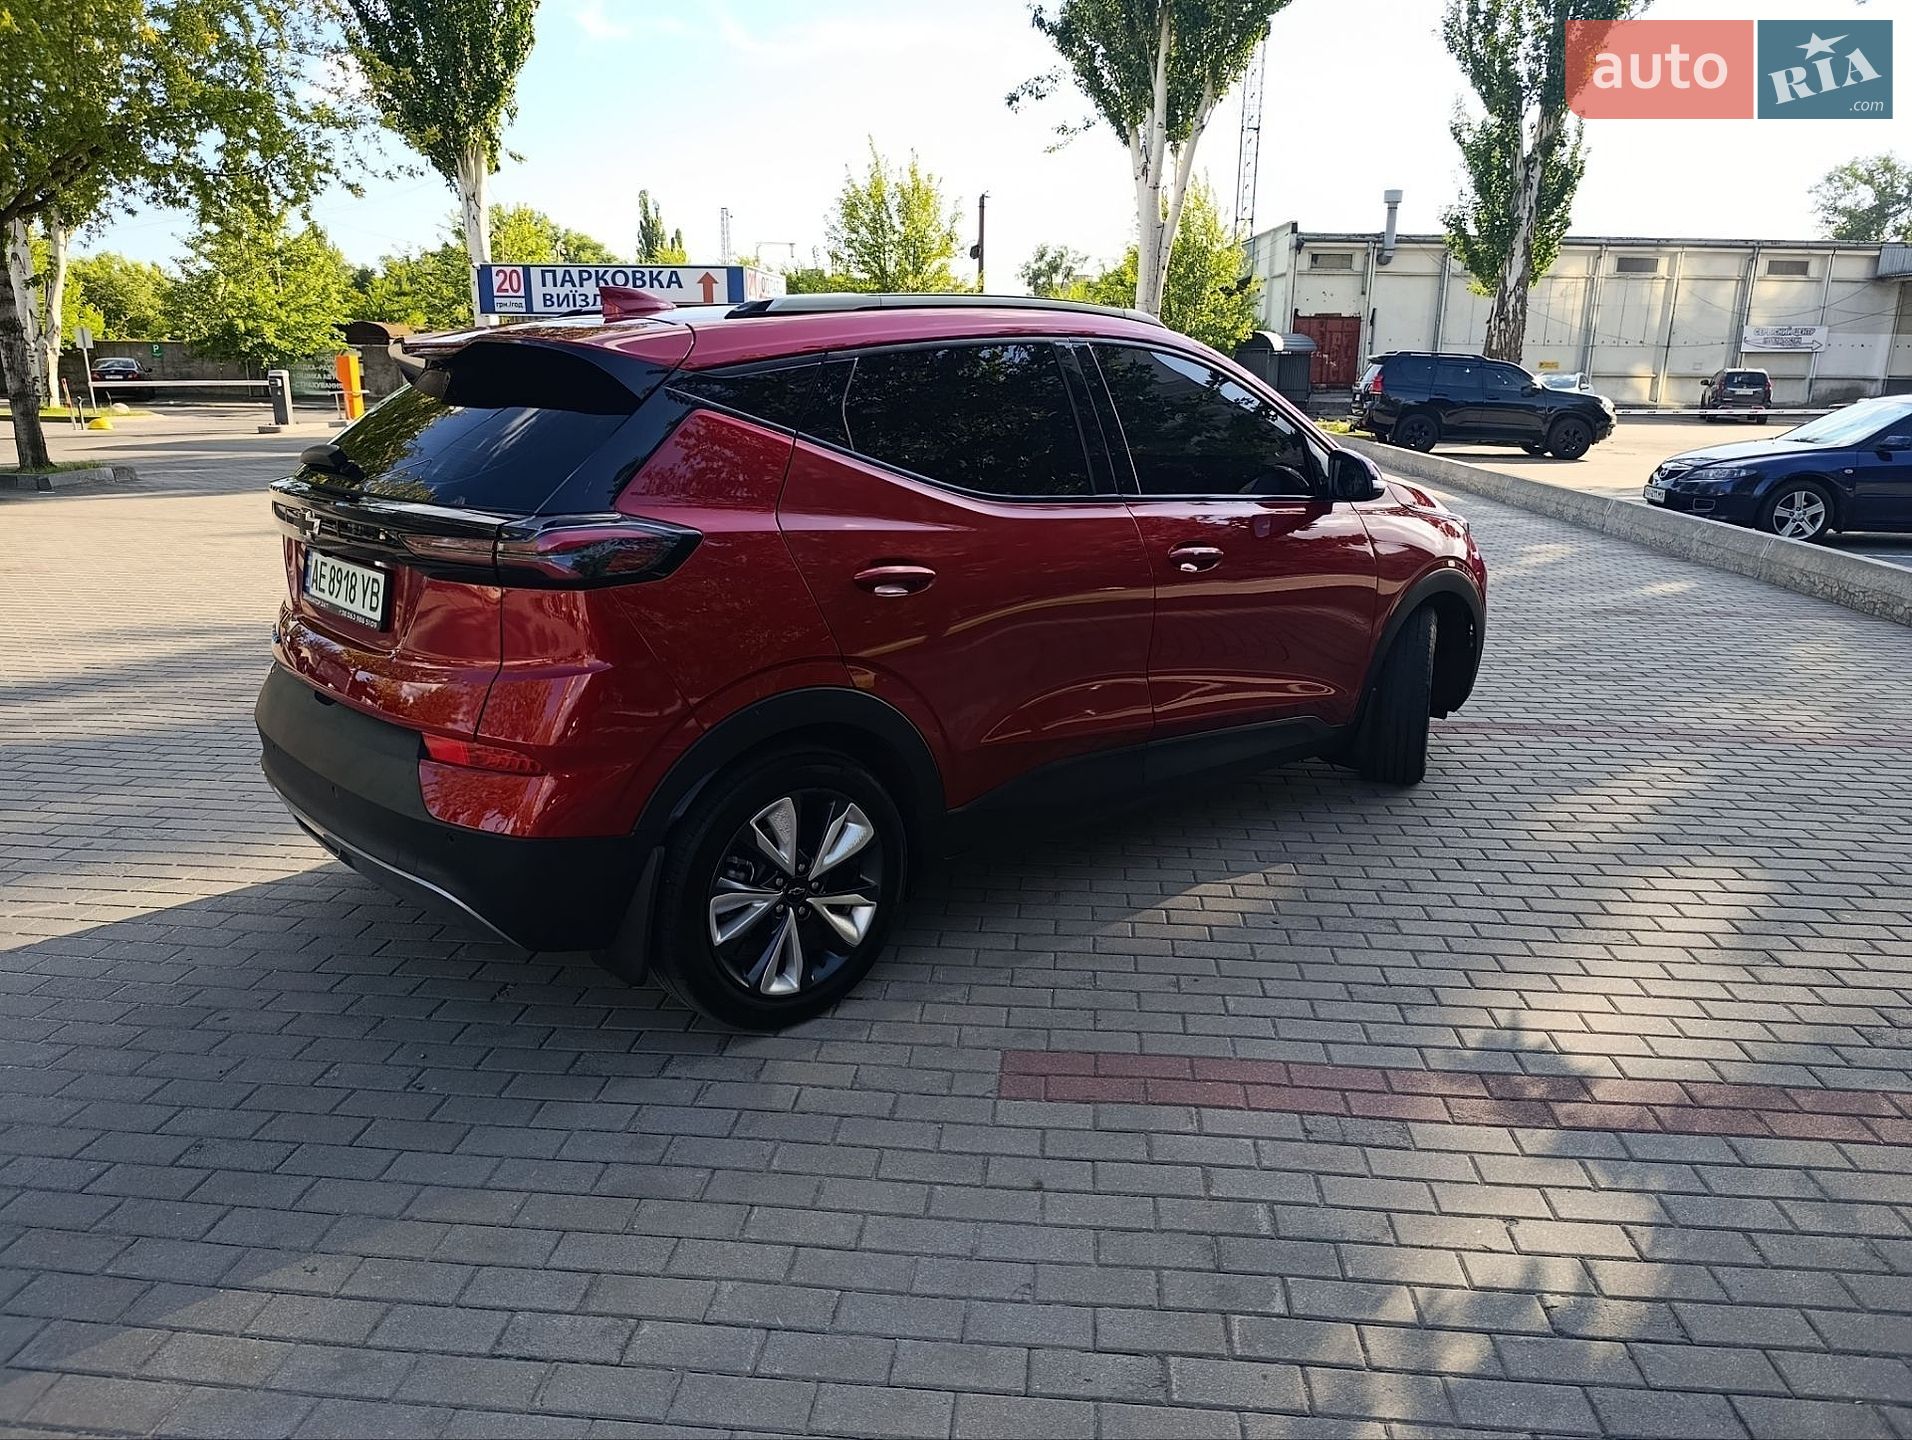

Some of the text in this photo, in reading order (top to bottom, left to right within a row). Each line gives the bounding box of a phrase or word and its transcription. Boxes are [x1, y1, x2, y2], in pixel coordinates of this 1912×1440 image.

[495, 269, 522, 294] 20
[540, 268, 684, 289] ПАРКОВКА
[311, 559, 380, 613] AE 8918 YB
